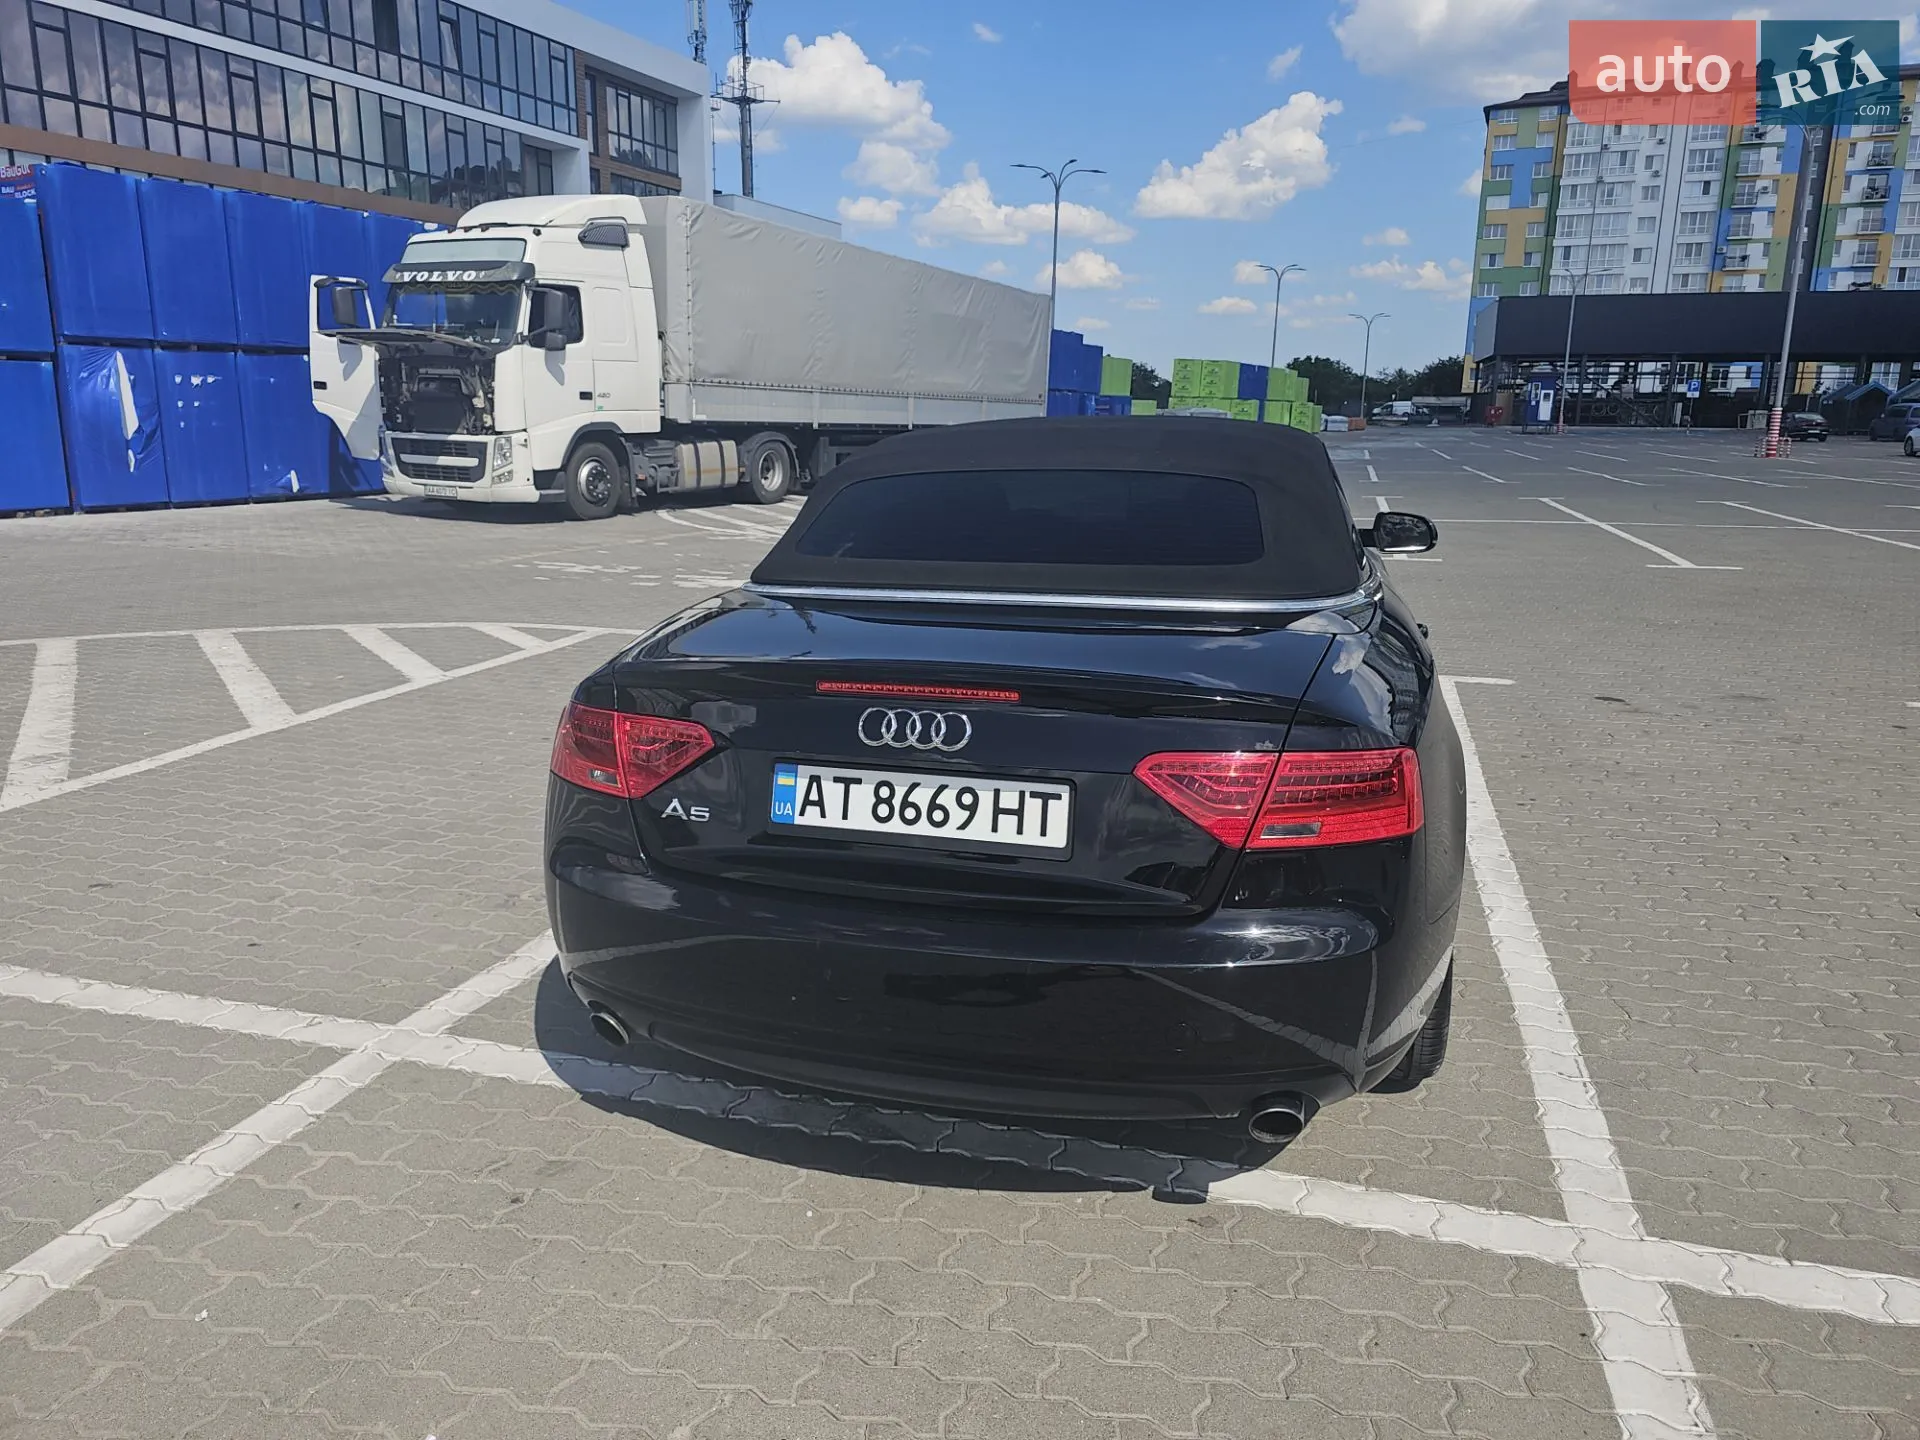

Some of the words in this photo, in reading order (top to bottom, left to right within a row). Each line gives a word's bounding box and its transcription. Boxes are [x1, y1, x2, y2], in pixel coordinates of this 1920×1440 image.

[402, 270, 477, 282] VOLVO
[1690, 381, 1699, 391] P
[660, 798, 710, 822] A5
[775, 801, 793, 816] UA
[799, 774, 862, 820] AT
[871, 780, 980, 831] 8669
[991, 788, 1063, 837] HT
